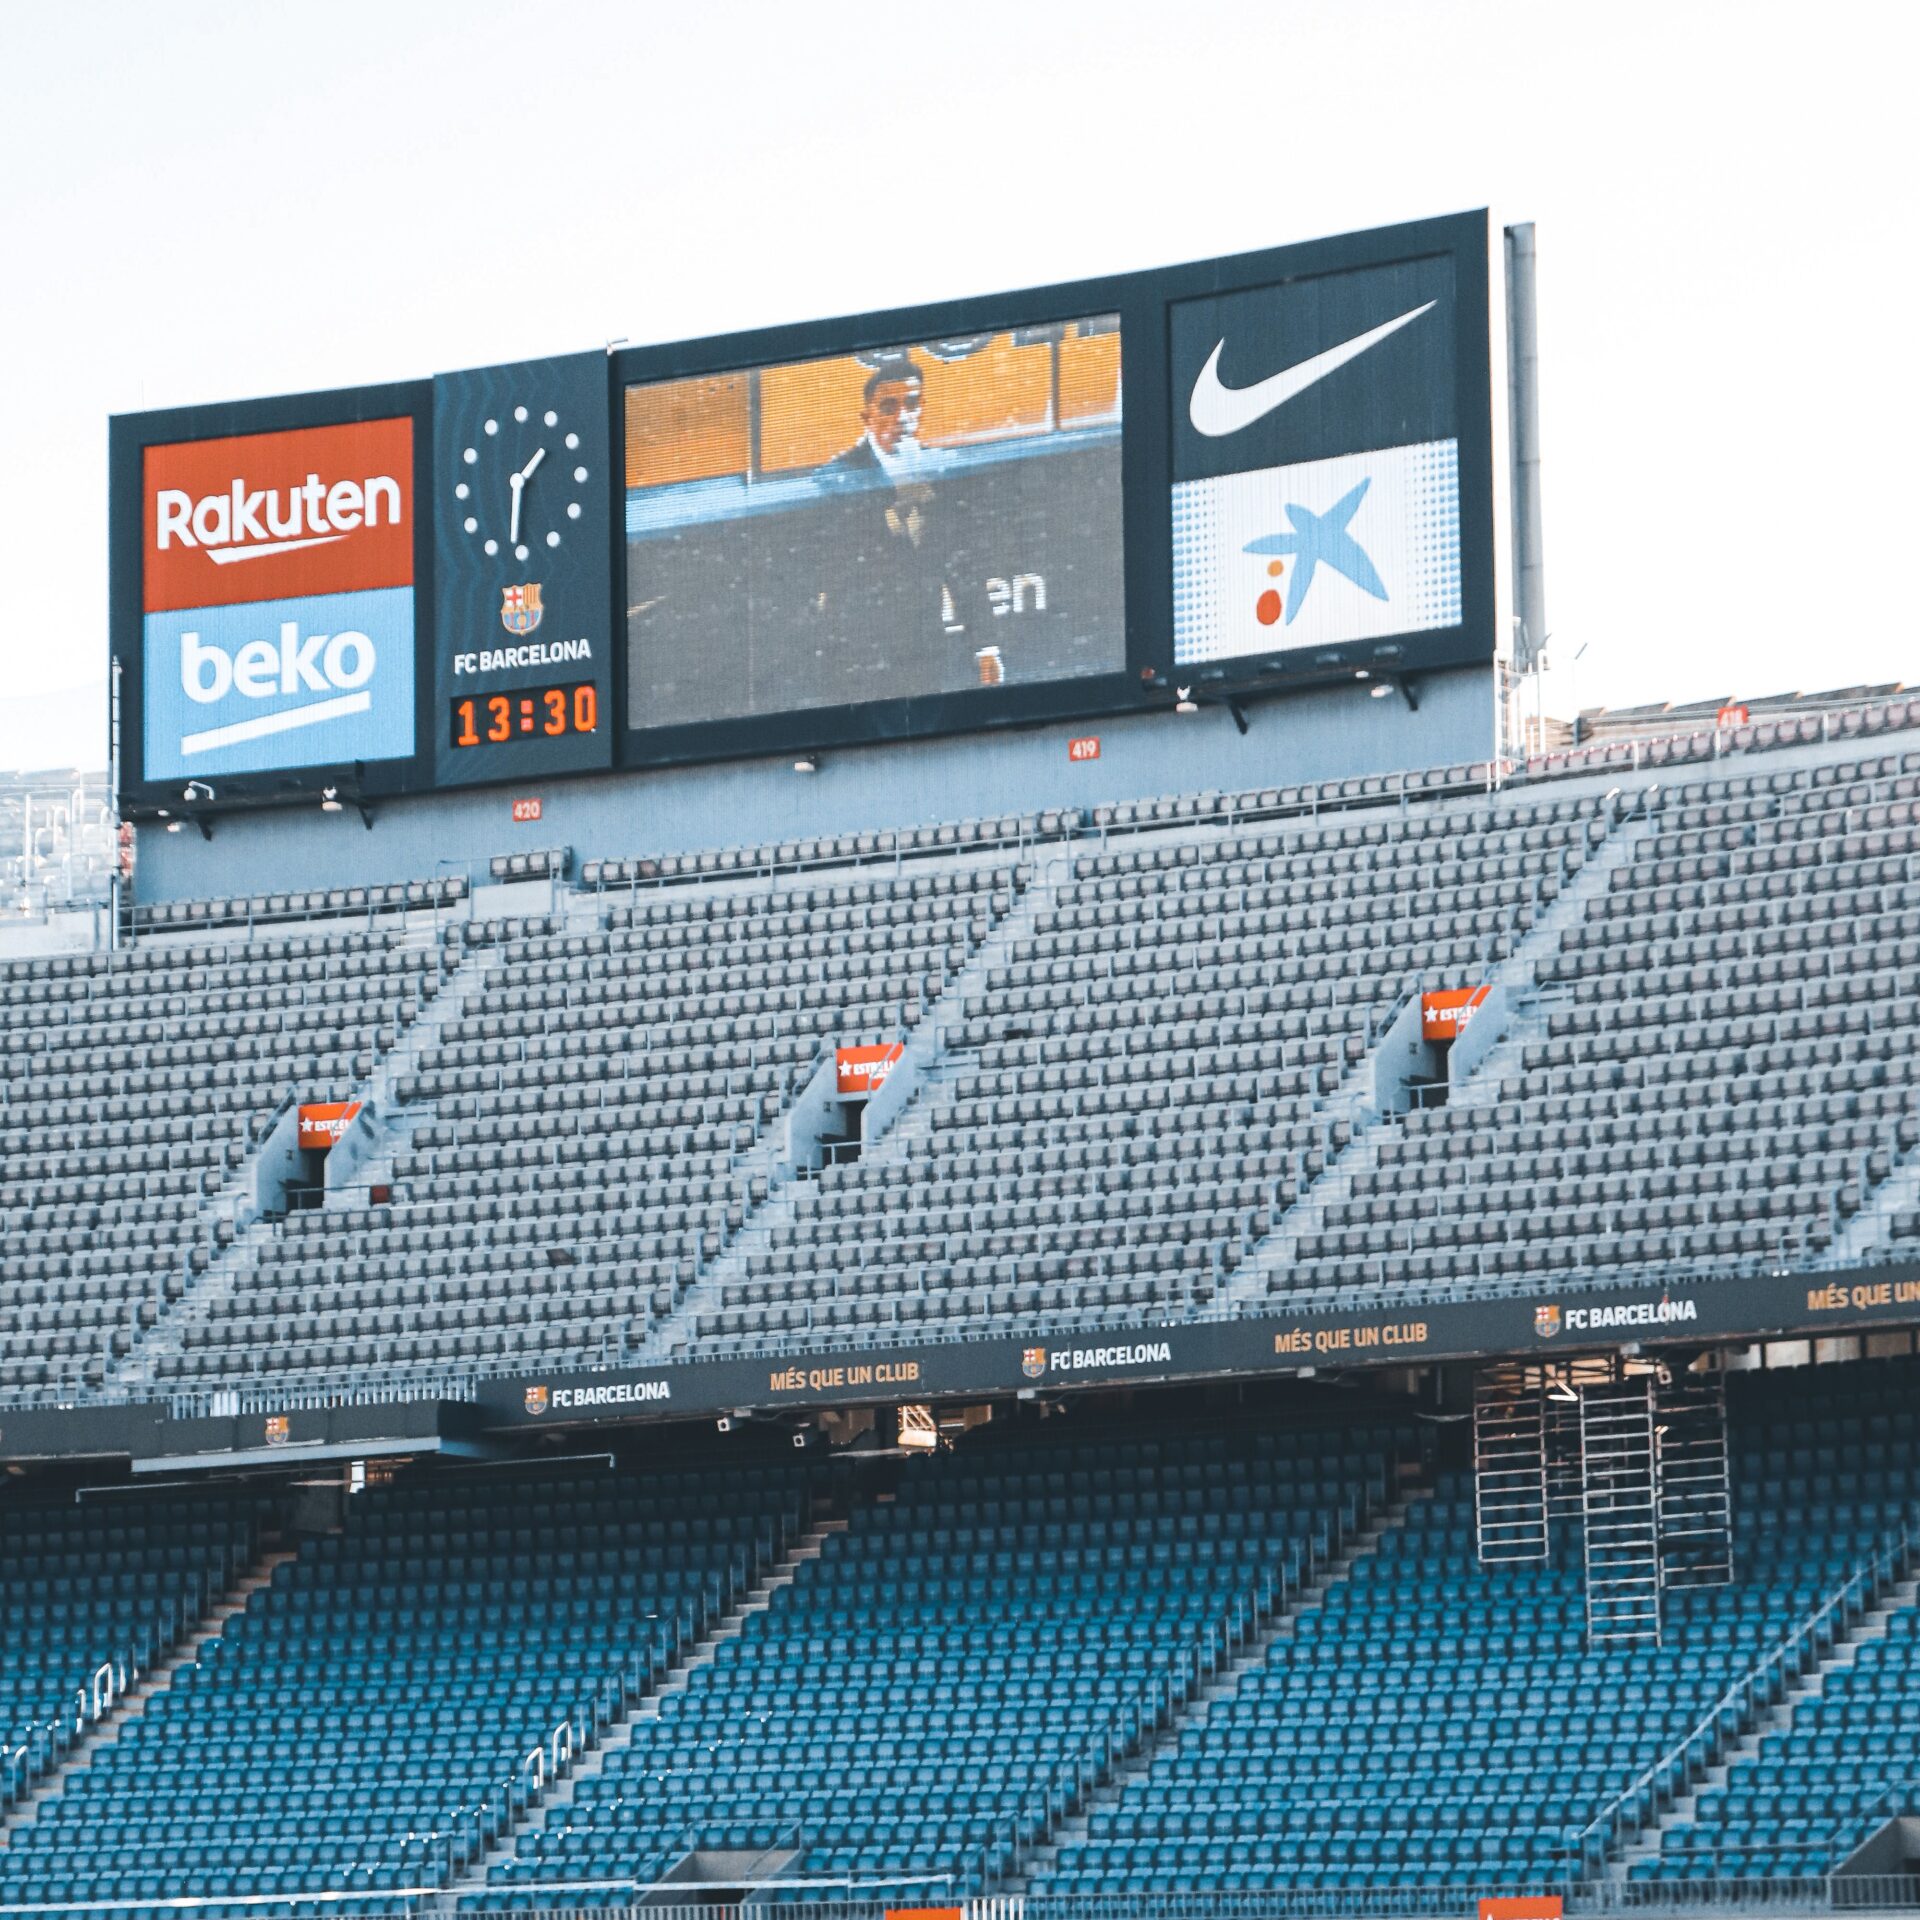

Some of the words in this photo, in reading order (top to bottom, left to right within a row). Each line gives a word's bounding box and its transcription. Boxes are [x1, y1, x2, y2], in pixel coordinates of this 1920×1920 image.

[157, 473, 401, 550] Rakuten
[181, 621, 376, 704] beko
[454, 652, 477, 675] FC
[479, 638, 592, 673] BARCELONA
[458, 685, 597, 747] 13:30
[1072, 739, 1097, 758] 419
[514, 801, 541, 819] 420
[1807, 1282, 1849, 1310] MÉS
[1852, 1283, 1892, 1310] QUE
[1565, 1309, 1588, 1330] FC
[1589, 1299, 1698, 1328] BARCELONA
[1274, 1328, 1312, 1353] MÉS
[1315, 1328, 1351, 1354] QUE
[1353, 1326, 1379, 1347] UN
[1382, 1322, 1428, 1345] CLUB
[1050, 1351, 1070, 1371] FC
[1073, 1342, 1172, 1369] BARCELONA
[770, 1366, 806, 1391] MÉS
[809, 1367, 844, 1391] QUE
[847, 1365, 872, 1385] UN
[875, 1361, 919, 1383] CLUB
[552, 1389, 572, 1408] FC
[573, 1380, 671, 1406] BARCELONA
